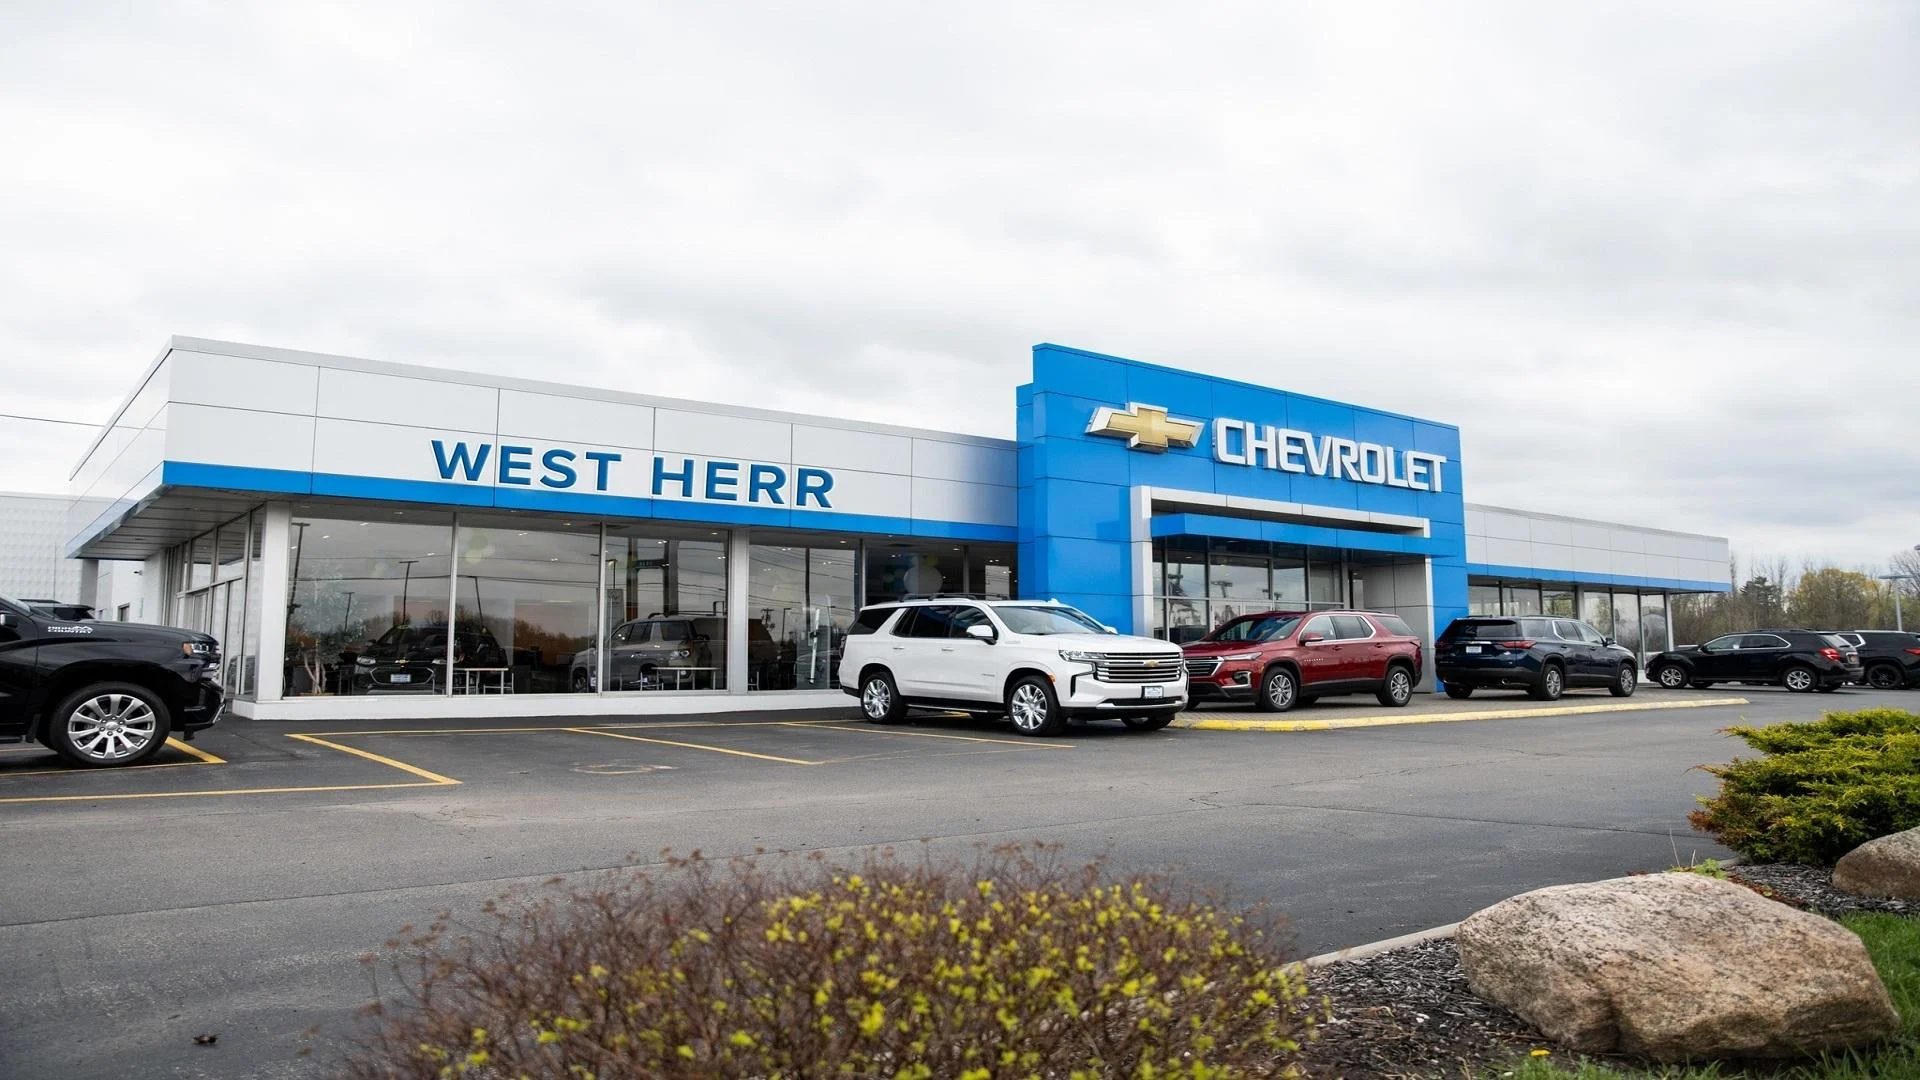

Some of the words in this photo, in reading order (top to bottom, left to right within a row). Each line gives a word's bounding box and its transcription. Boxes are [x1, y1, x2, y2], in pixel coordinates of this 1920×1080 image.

[430, 439, 622, 492] WEST
[651, 456, 834, 508] HERR
[1212, 417, 1448, 493] CHEVROLET
